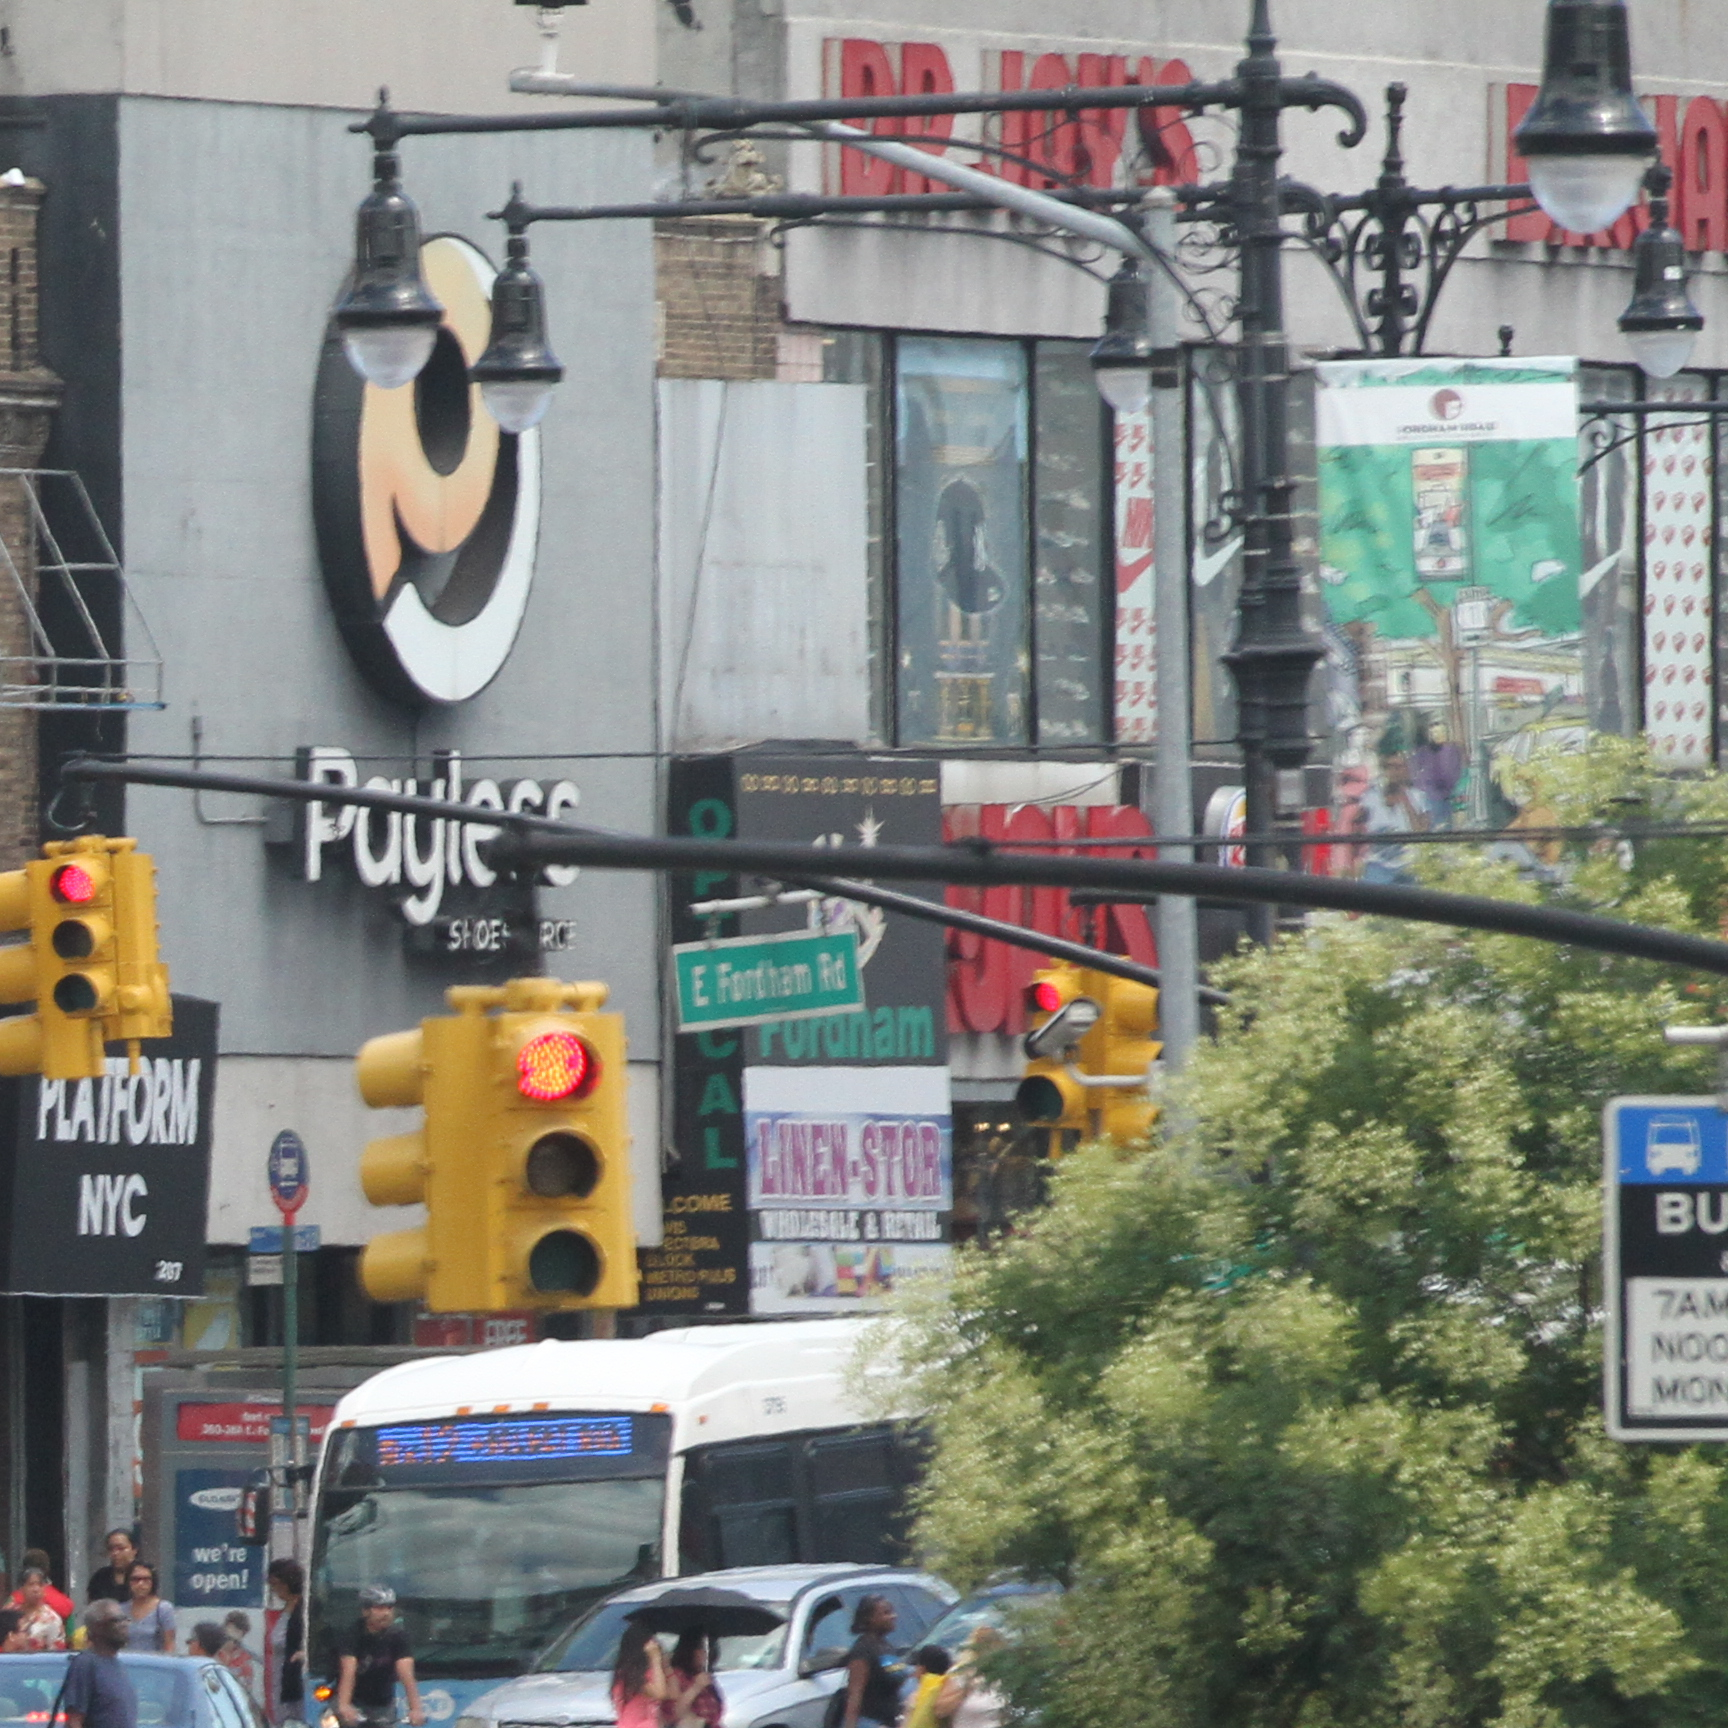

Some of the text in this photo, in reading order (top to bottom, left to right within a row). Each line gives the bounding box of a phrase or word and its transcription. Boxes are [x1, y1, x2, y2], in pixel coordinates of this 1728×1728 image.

[691, 951, 847, 1007] E Fordham Rd
[37, 1056, 202, 1146] PLATFORM
[79, 1172, 149, 1238] NYC
[191, 1568, 250, 1594] open!
[192, 1543, 248, 1563] we're
